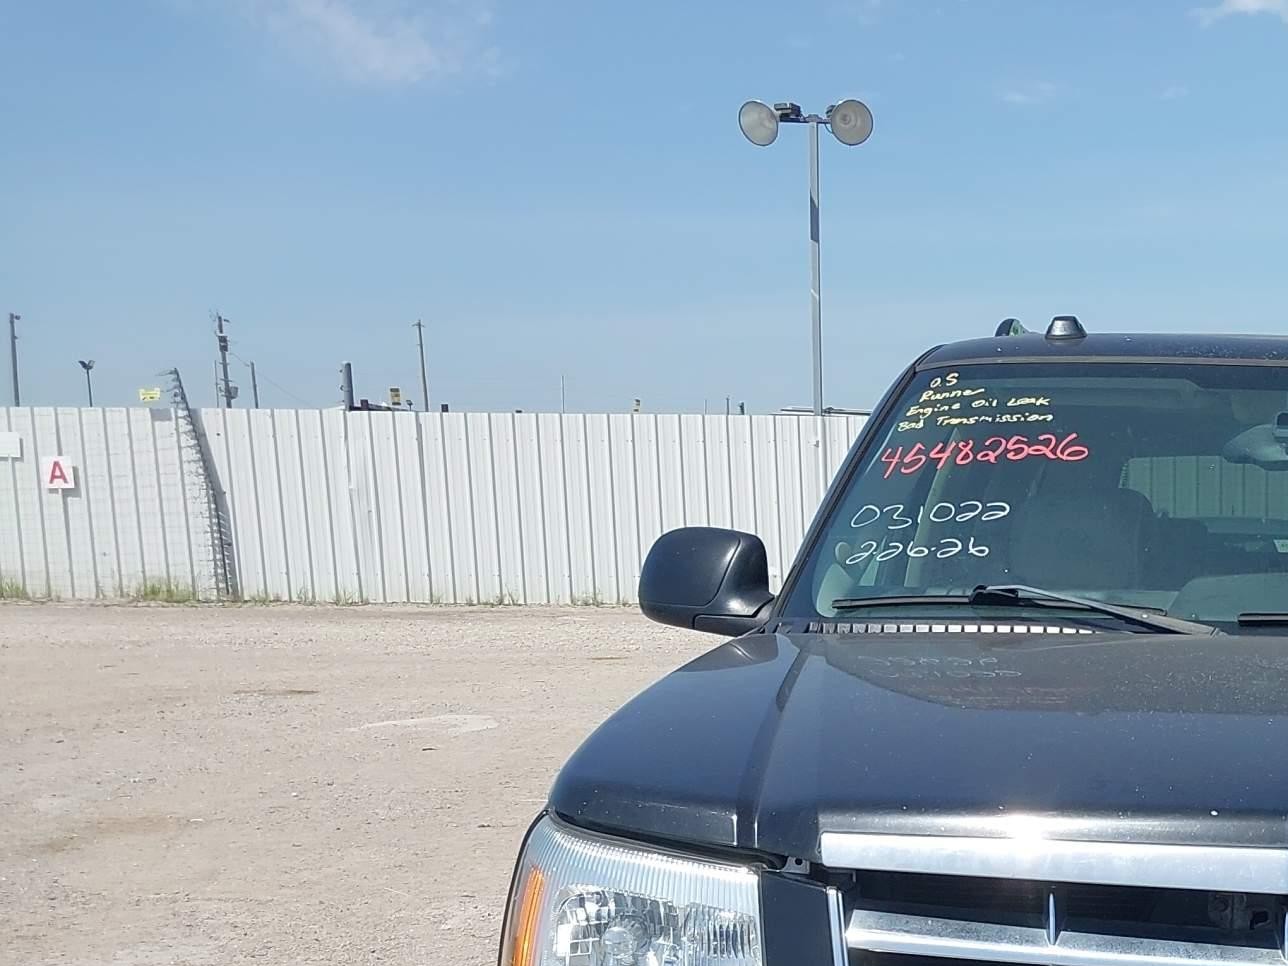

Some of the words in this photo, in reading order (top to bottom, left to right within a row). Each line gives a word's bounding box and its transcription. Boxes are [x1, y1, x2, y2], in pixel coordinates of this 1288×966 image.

[919, 388, 985, 403] Runner
[906, 402, 961, 419] Engine
[971, 398, 998, 409] Oil
[881, 433, 1089, 479] 45482526
[49, 460, 68, 484] A
[850, 500, 1011, 530] 031022
